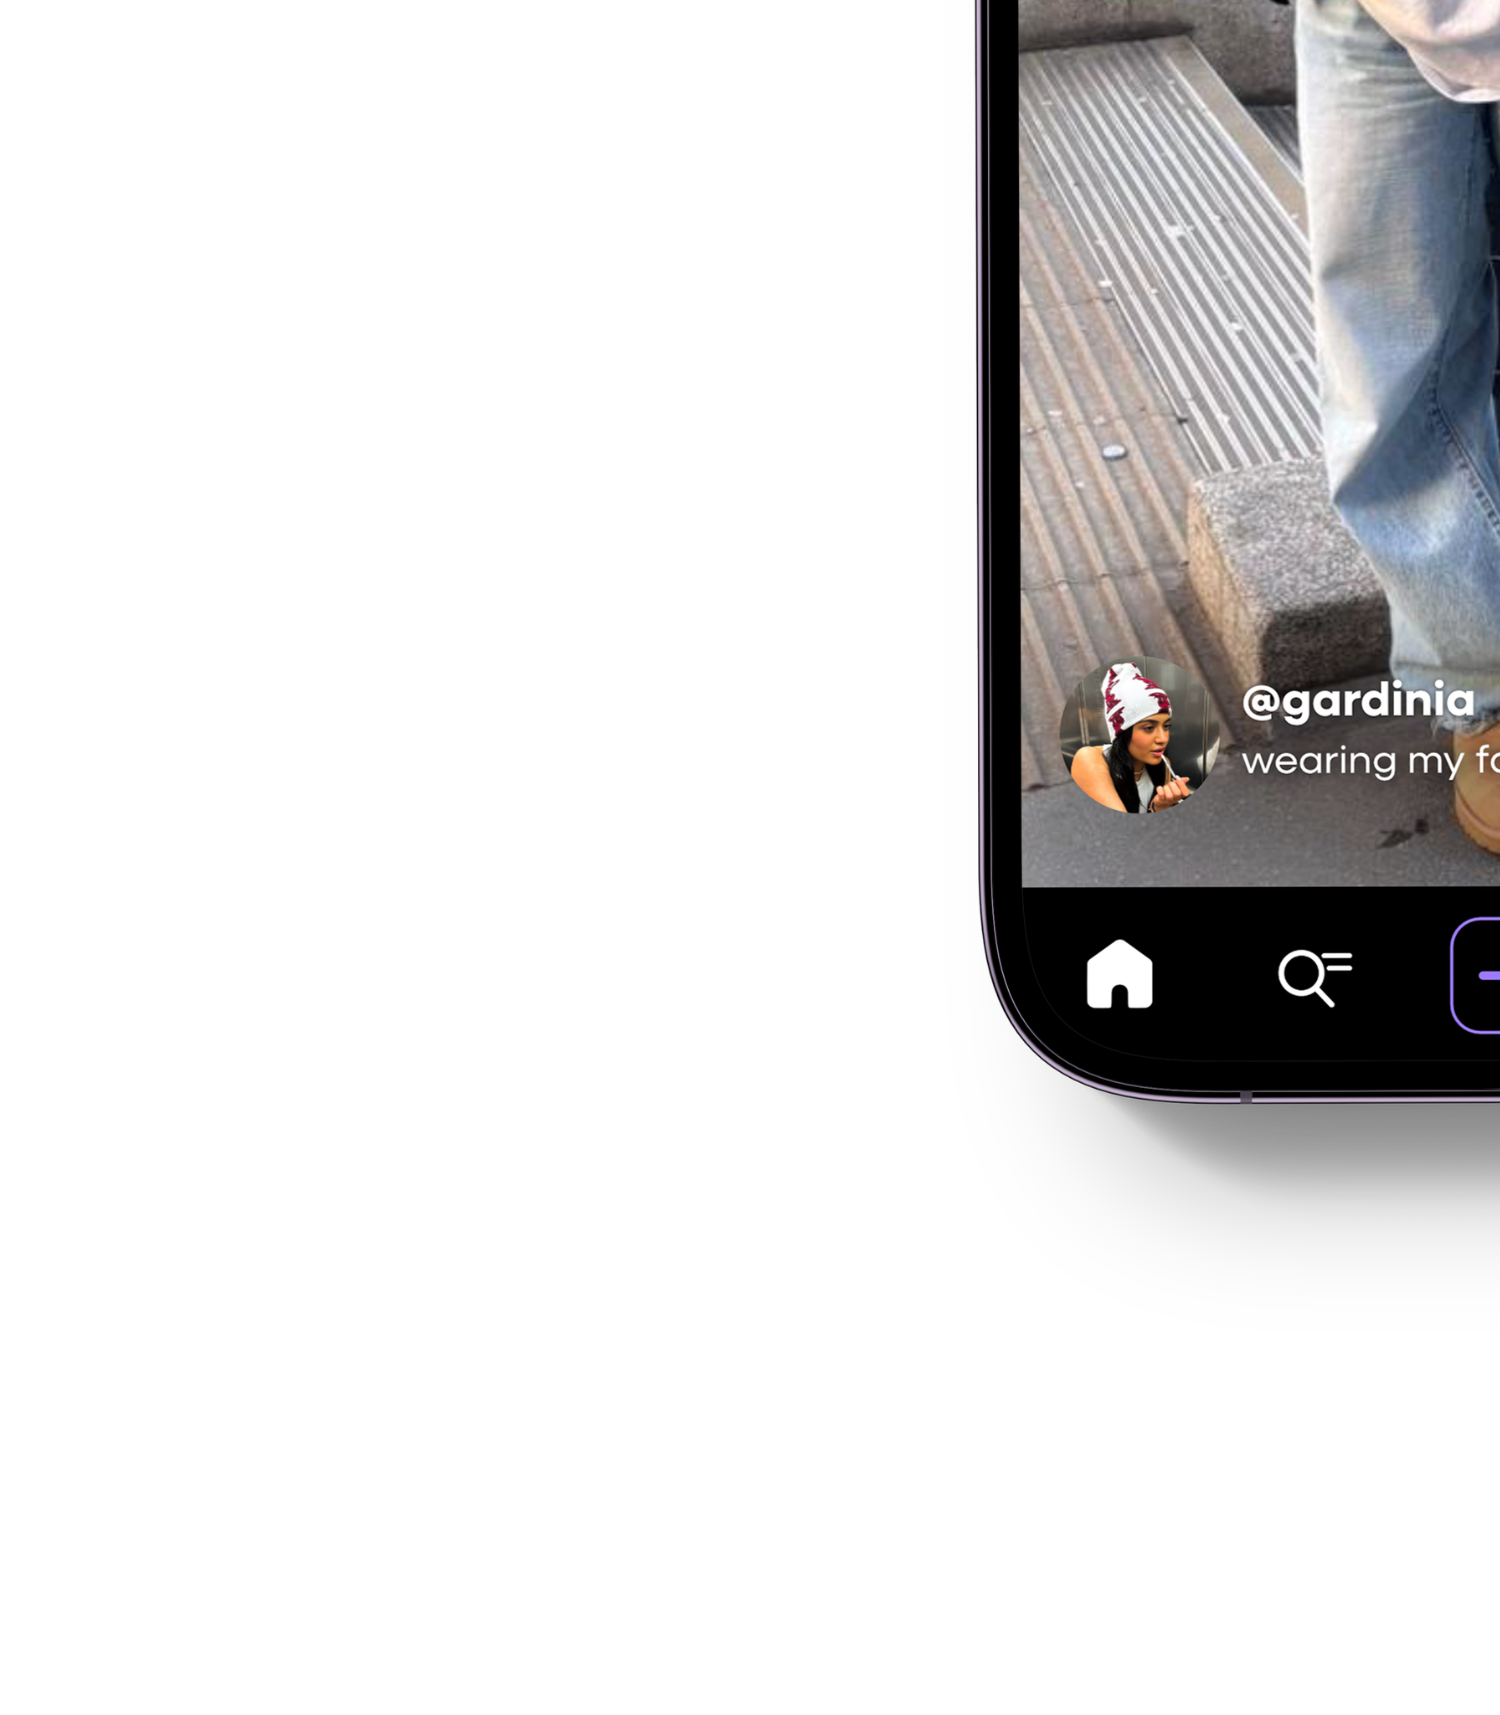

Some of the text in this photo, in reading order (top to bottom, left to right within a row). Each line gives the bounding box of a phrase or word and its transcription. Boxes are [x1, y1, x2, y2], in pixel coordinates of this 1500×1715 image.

[1242, 678, 1475, 725] @gardinia
[1241, 745, 1396, 781] wearing
[1409, 752, 1465, 781] my
